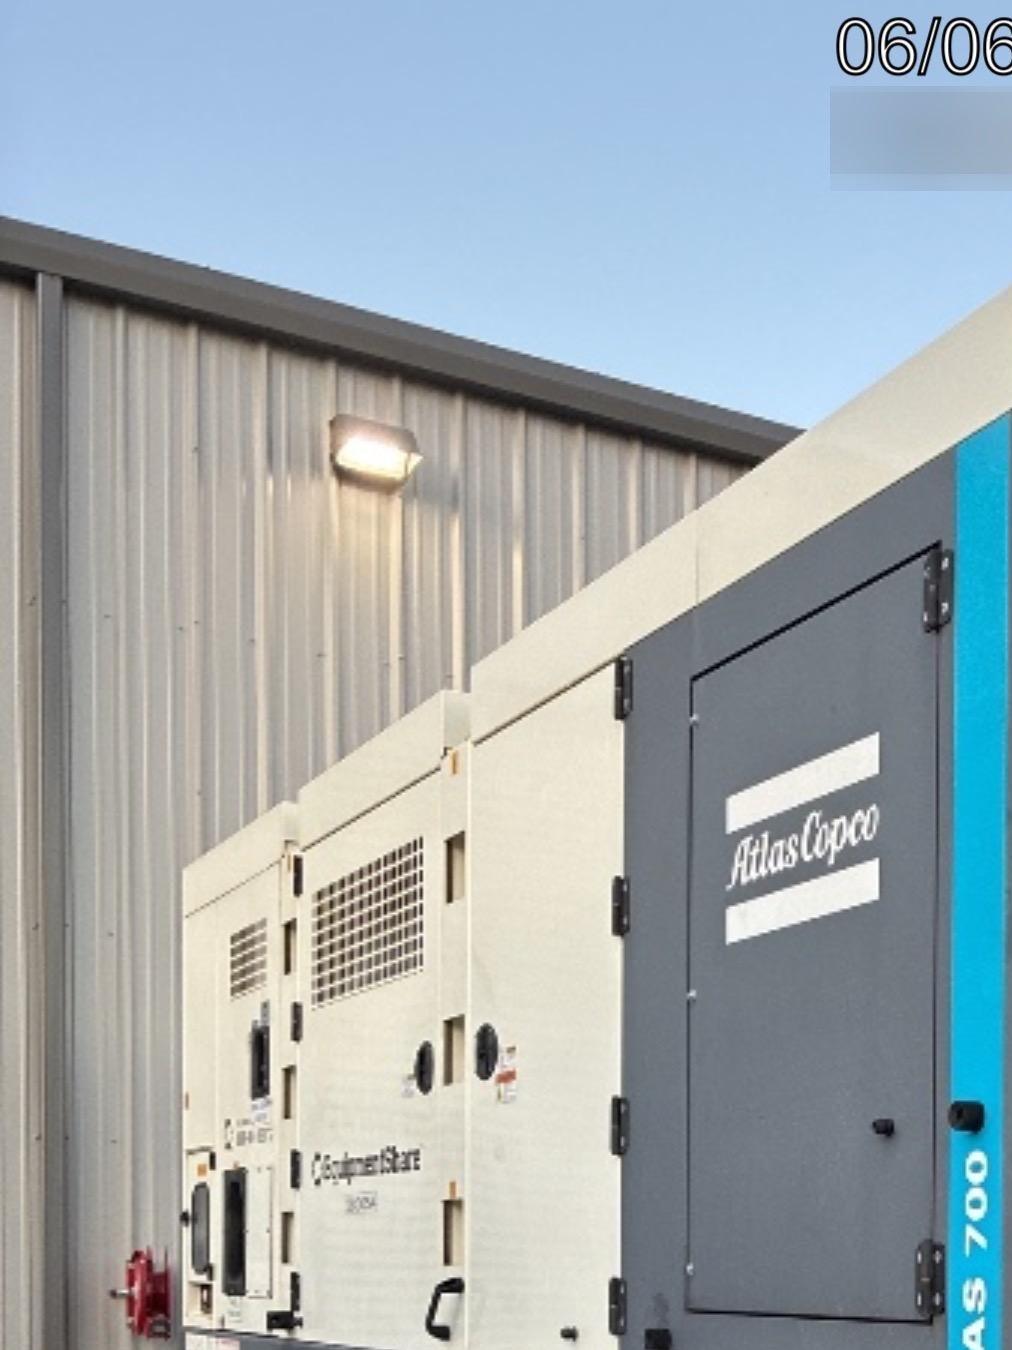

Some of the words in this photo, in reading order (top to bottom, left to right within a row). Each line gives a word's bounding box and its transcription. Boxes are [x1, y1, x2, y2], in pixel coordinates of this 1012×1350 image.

[725, 833, 799, 892] Atlas
[800, 804, 880, 867] Copco
[965, 1149, 989, 1258] 700
